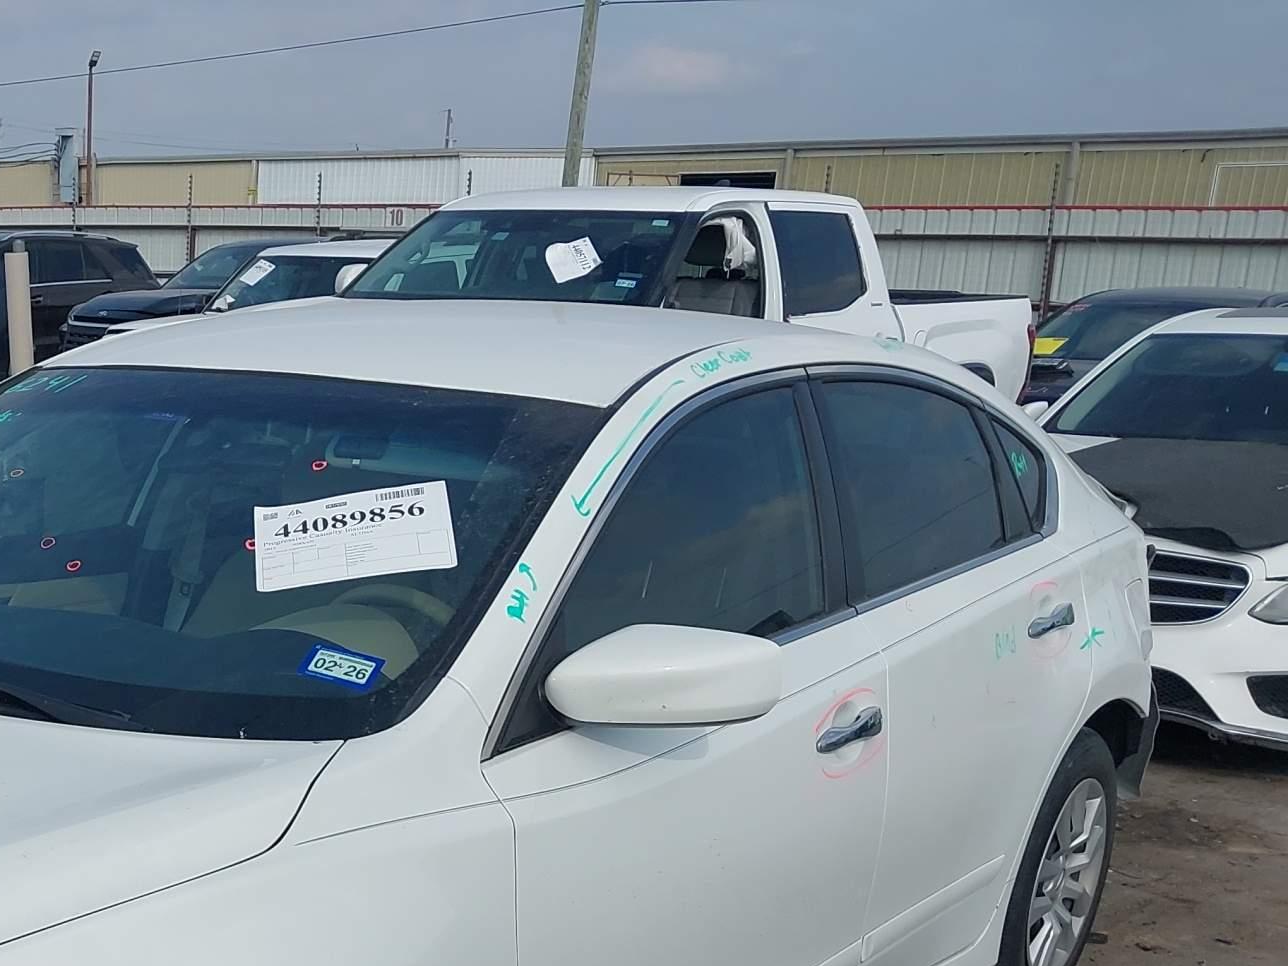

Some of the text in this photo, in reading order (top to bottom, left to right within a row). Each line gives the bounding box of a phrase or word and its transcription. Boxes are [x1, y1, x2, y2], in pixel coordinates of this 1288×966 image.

[390, 209, 403, 226] 10
[274, 499, 425, 538] 44089856
[263, 536, 308, 547] Progressive
